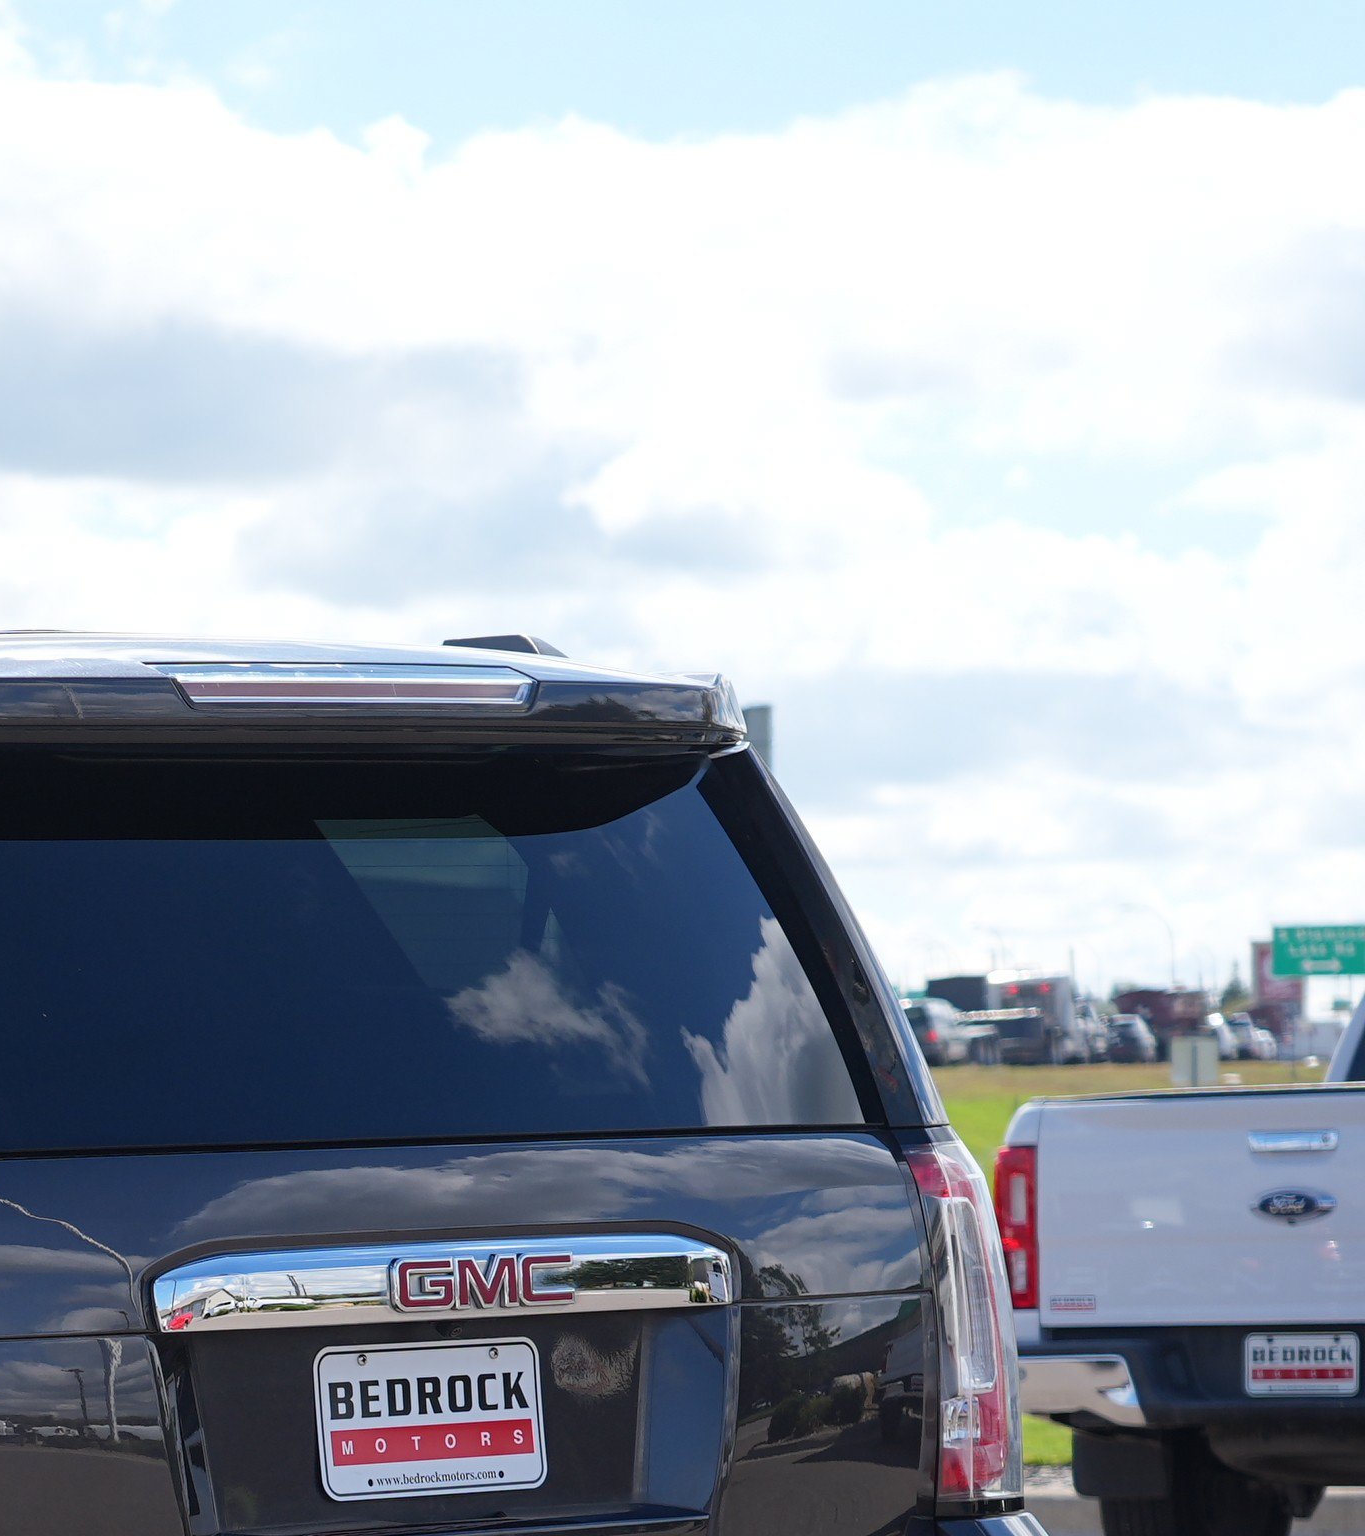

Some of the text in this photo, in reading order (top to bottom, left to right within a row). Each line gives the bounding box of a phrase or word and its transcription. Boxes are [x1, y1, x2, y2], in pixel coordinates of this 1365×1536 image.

[388, 1251, 575, 1313] GMC
[1252, 1346, 1353, 1362] BEDROCK
[327, 1371, 530, 1420] BEDROCK
[341, 1429, 525, 1456] MOTORS
[376, 1468, 498, 1488] www.bedrockmotors.com
